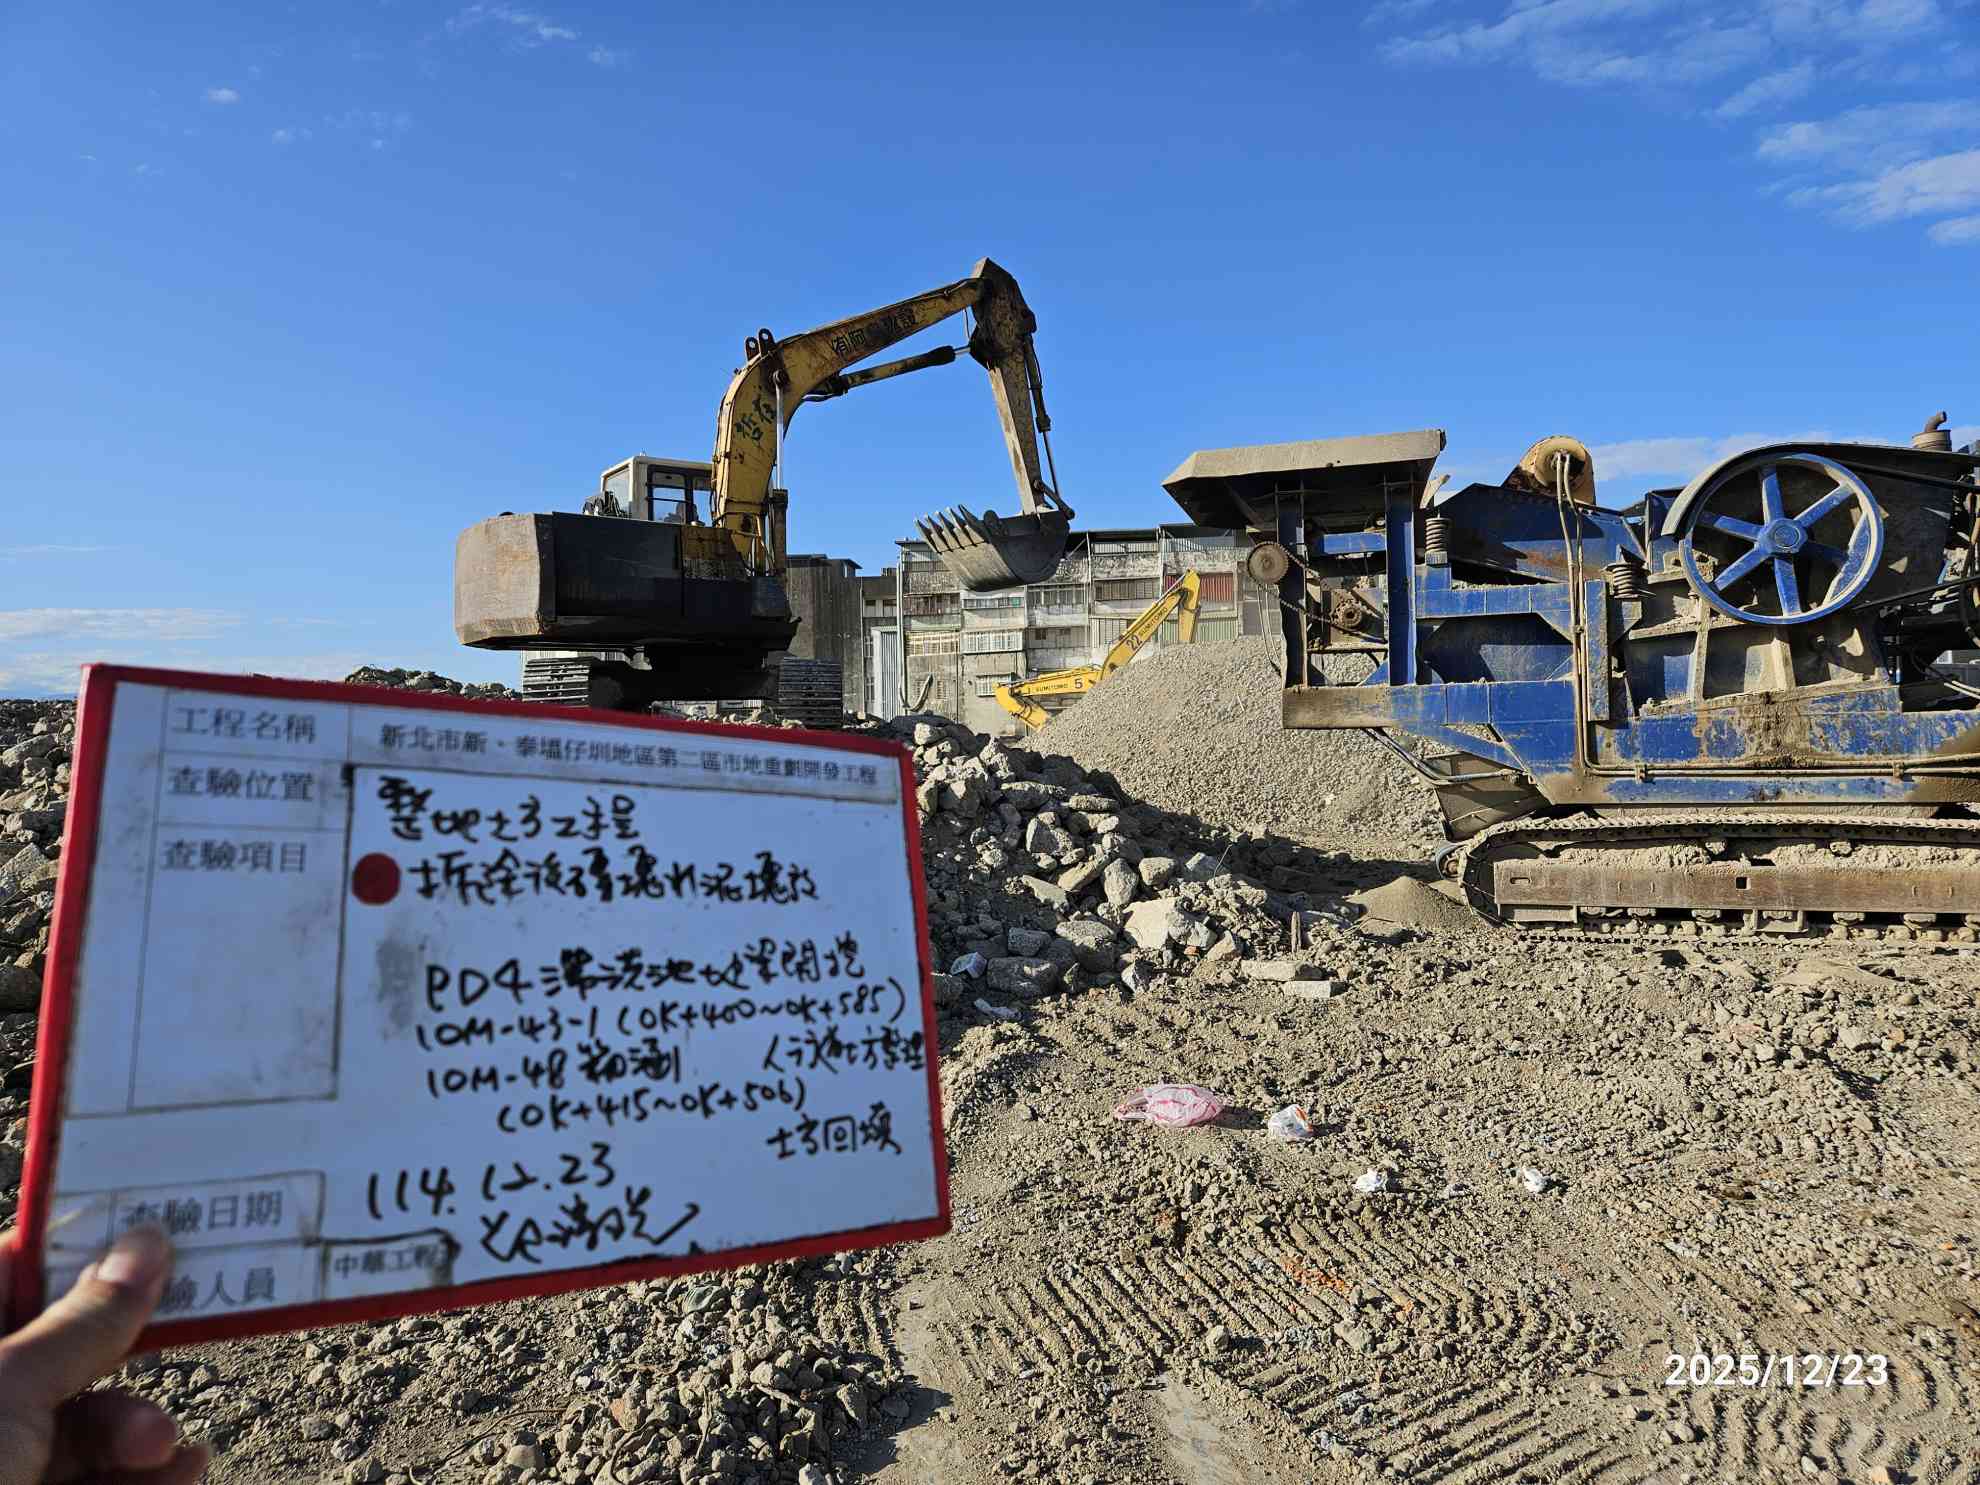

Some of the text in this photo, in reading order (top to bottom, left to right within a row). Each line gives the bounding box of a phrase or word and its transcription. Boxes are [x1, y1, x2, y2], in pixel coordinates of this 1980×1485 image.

[173, 708, 315, 744] 工程名稱
[168, 766, 314, 802] 查驗位置
[160, 841, 307, 874] 查驗項目
